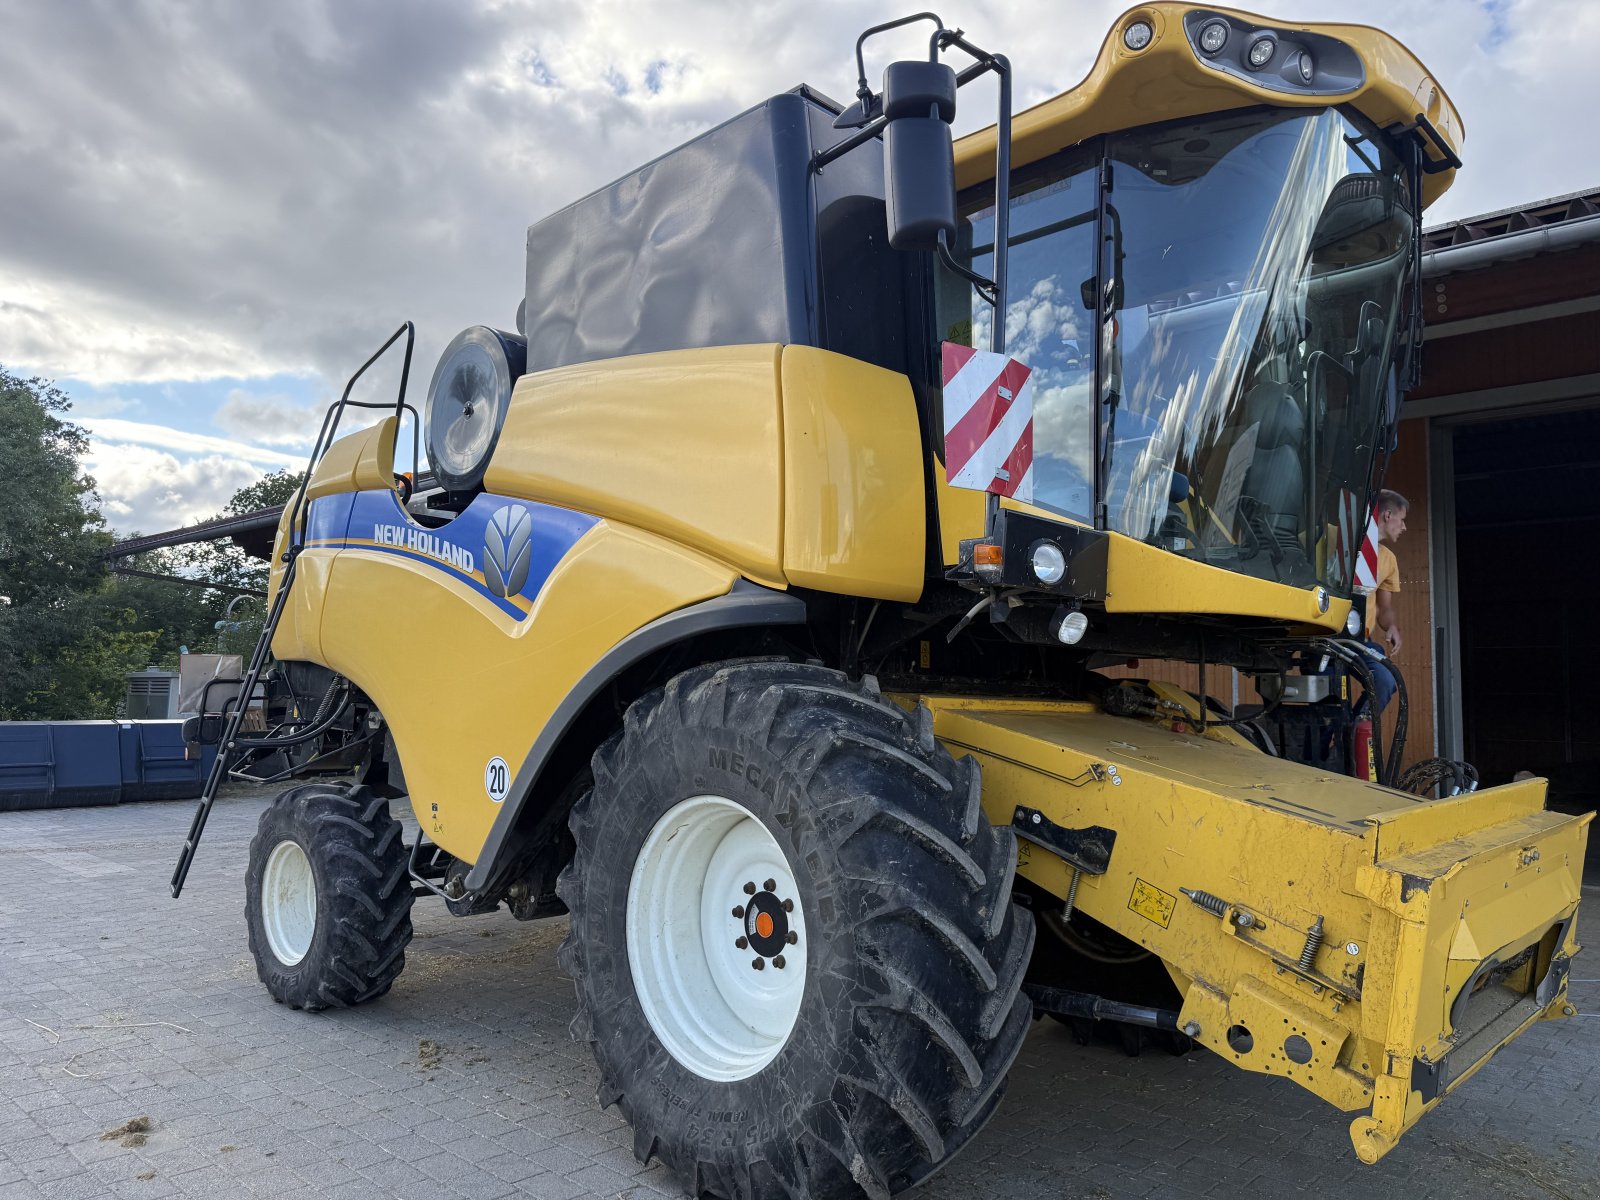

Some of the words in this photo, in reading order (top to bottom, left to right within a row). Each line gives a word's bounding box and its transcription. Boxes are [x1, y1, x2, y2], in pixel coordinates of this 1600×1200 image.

[374, 523, 405, 547] NEW
[407, 529, 474, 574] HOLLAND
[490, 765, 505, 794] 20
[708, 744, 776, 803] MEGA
